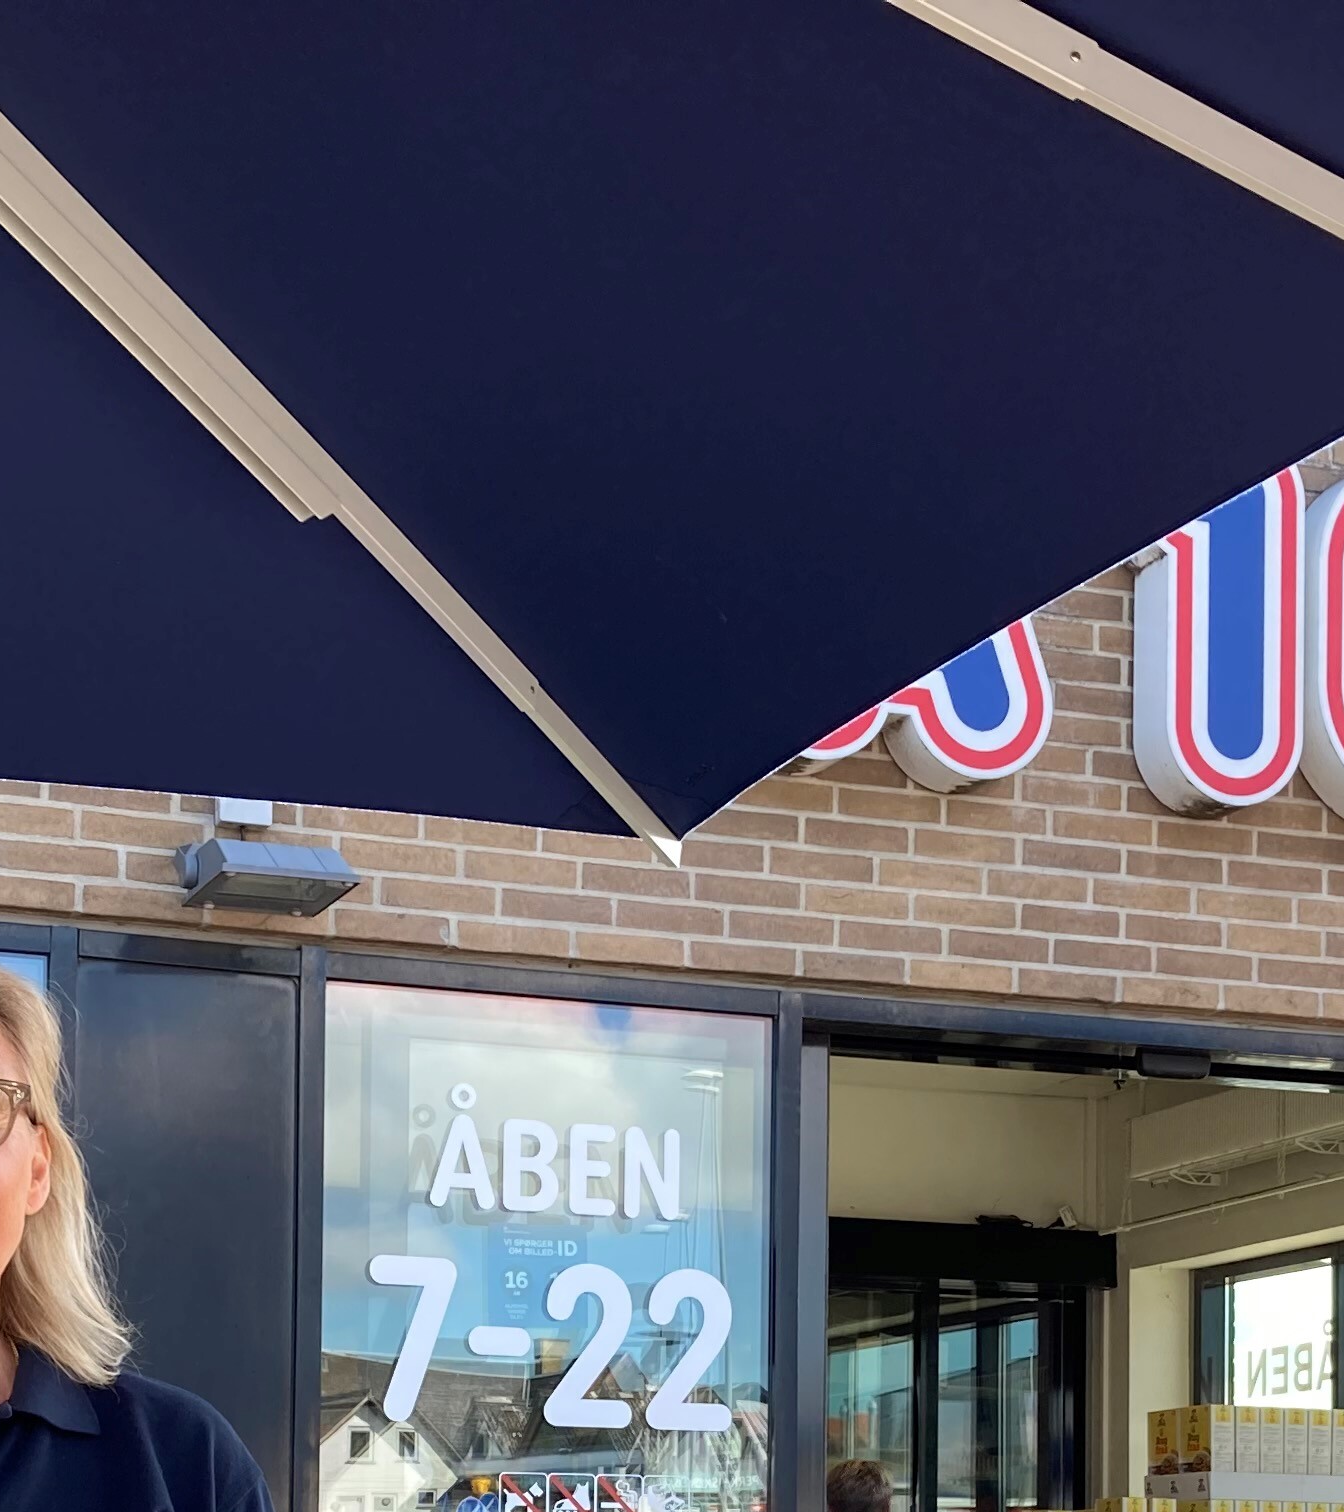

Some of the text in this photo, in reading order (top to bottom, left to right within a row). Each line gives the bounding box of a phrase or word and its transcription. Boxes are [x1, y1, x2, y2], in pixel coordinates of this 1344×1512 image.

[429, 1082, 680, 1221] ÅBEN
[369, 1254, 732, 1432] 7-22
[504, 1271, 528, 1289] 16
